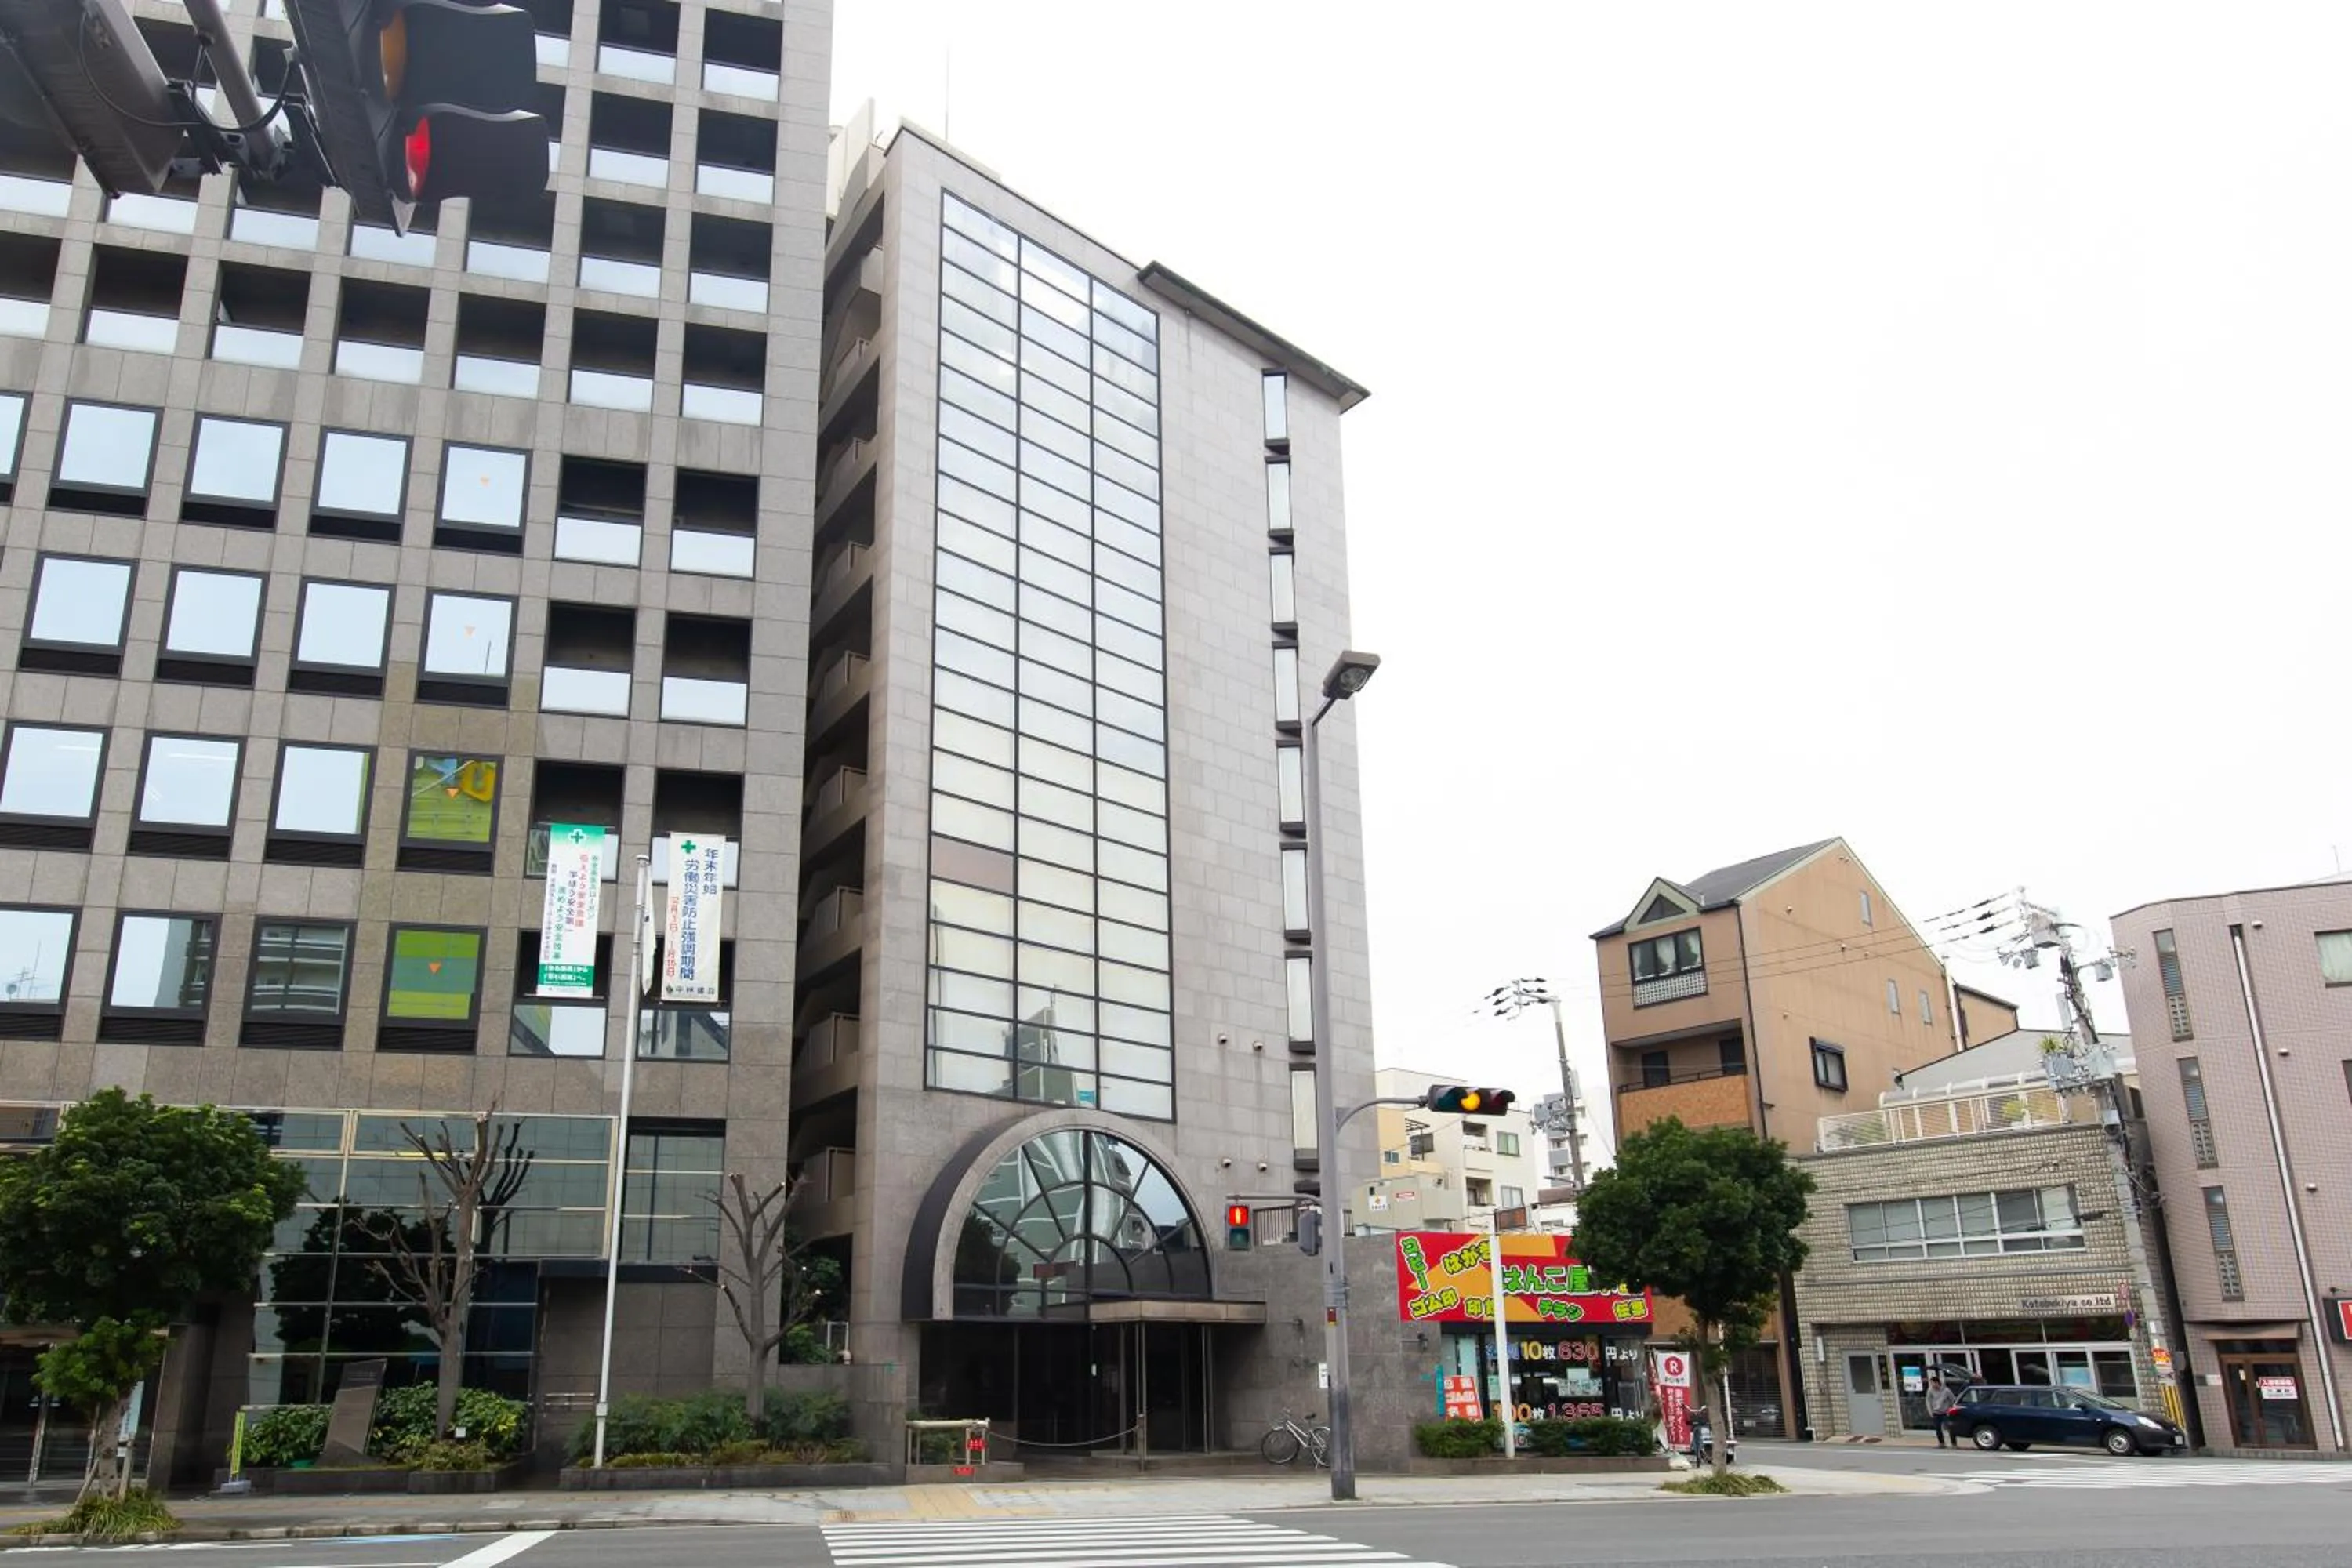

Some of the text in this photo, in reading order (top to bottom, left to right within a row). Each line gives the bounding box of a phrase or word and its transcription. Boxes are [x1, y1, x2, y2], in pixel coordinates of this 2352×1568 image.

[703, 848, 719, 895] 年末年始
[679, 858, 700, 982] 労働災害防止強調期間
[1410, 1287, 1456, 1318] ゴム印
